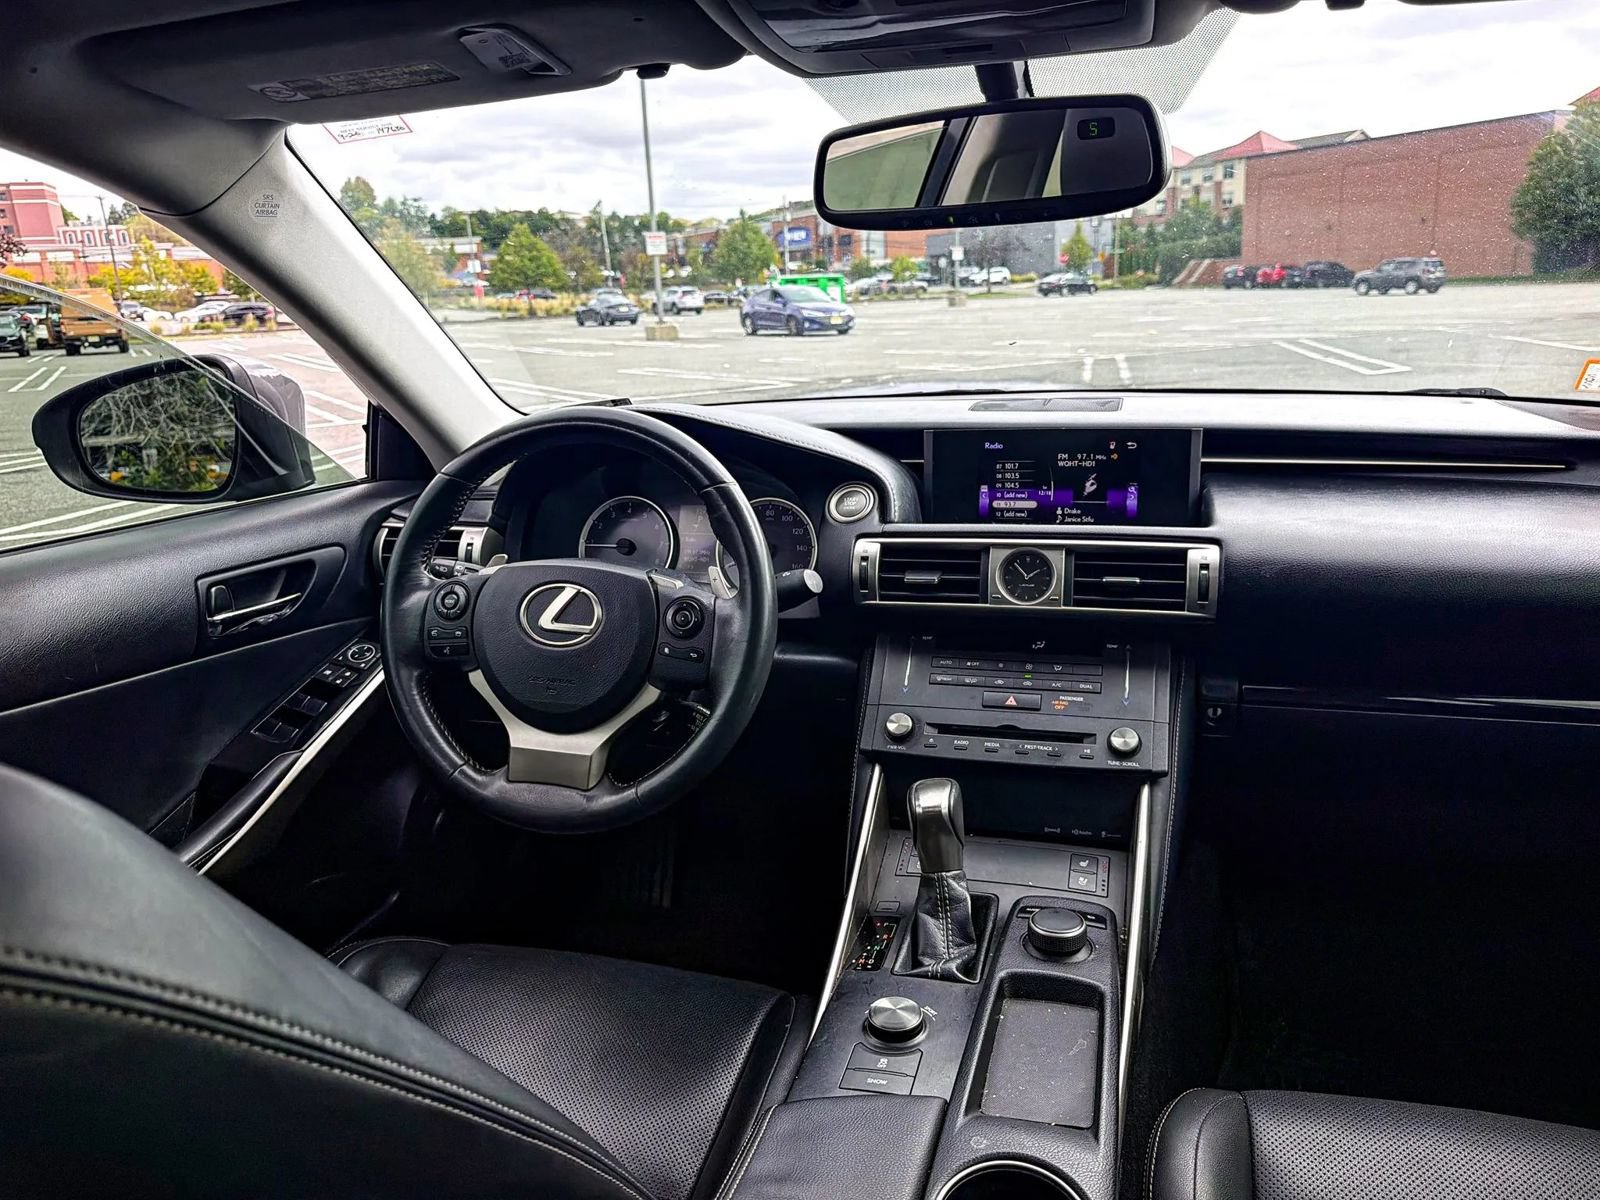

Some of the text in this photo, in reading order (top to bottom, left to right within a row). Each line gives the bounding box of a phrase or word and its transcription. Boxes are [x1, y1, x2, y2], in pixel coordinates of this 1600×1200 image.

[984, 442, 1004, 450] Radio
[1063, 515, 1082, 523] Janice
[866, 1077, 888, 1085] SNOW
